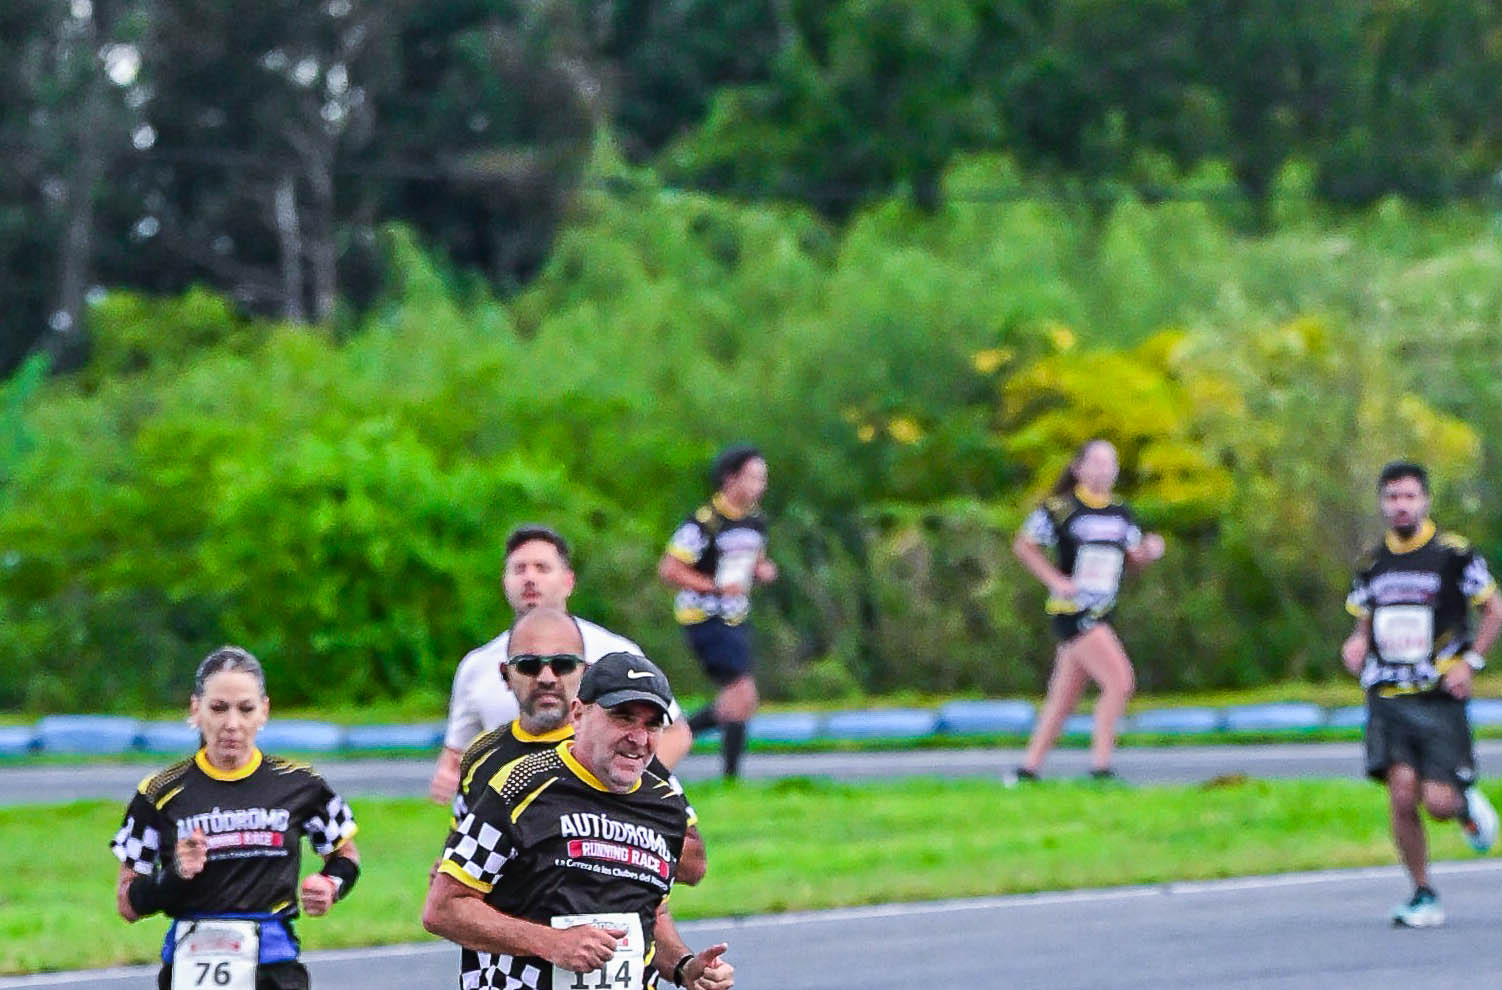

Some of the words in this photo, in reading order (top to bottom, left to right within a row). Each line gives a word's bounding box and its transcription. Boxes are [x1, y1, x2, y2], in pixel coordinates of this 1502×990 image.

[581, 842, 629, 862] RUNNING
[631, 850, 661, 874] RACE
[194, 961, 231, 987] 76
[570, 960, 632, 990] 114
